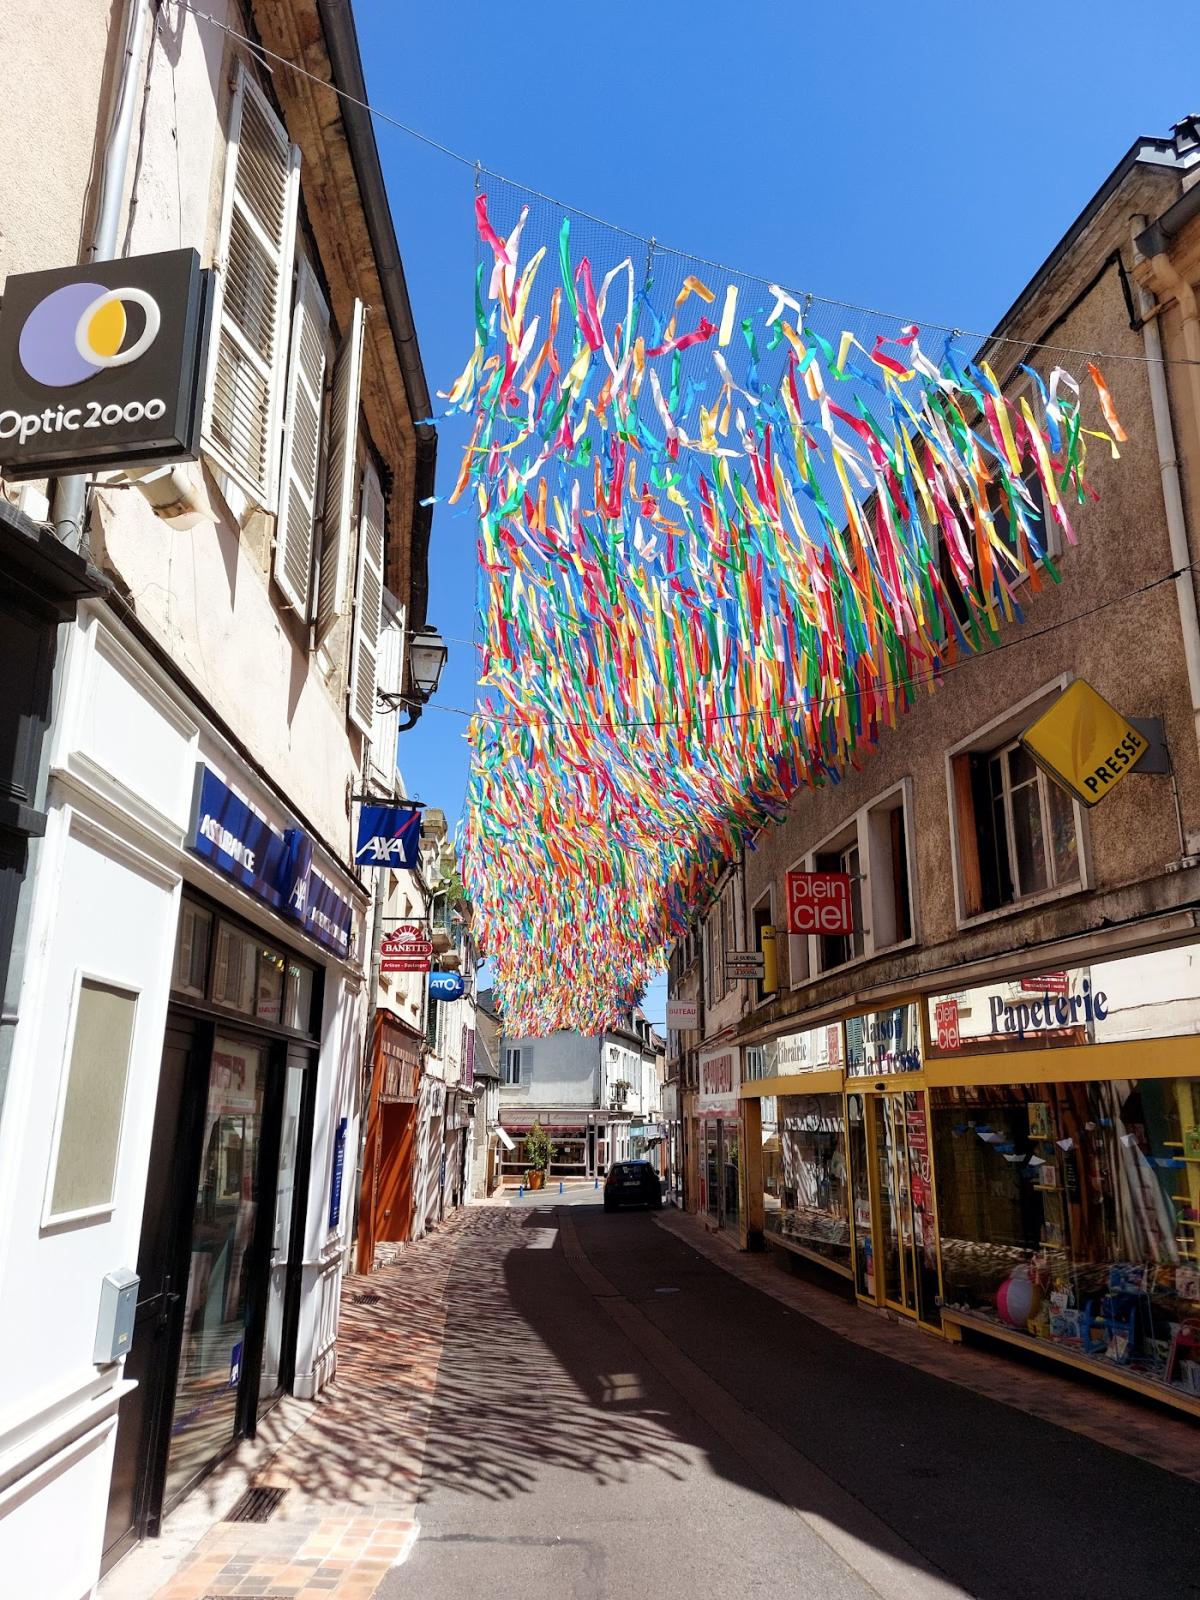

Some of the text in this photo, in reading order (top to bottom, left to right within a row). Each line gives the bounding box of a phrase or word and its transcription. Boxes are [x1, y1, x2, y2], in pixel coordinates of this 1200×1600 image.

[0, 404, 82, 444] Optic
[1083, 732, 1142, 794] PRESSE
[355, 836, 407, 862] AXA
[792, 875, 846, 903] plein
[794, 897, 848, 930] ciel
[385, 944, 428, 952] BANETTE
[430, 978, 462, 991] ATOL
[937, 1002, 957, 1028] plein
[988, 979, 1109, 1041] Papeterie
[938, 1020, 960, 1049] ciel
